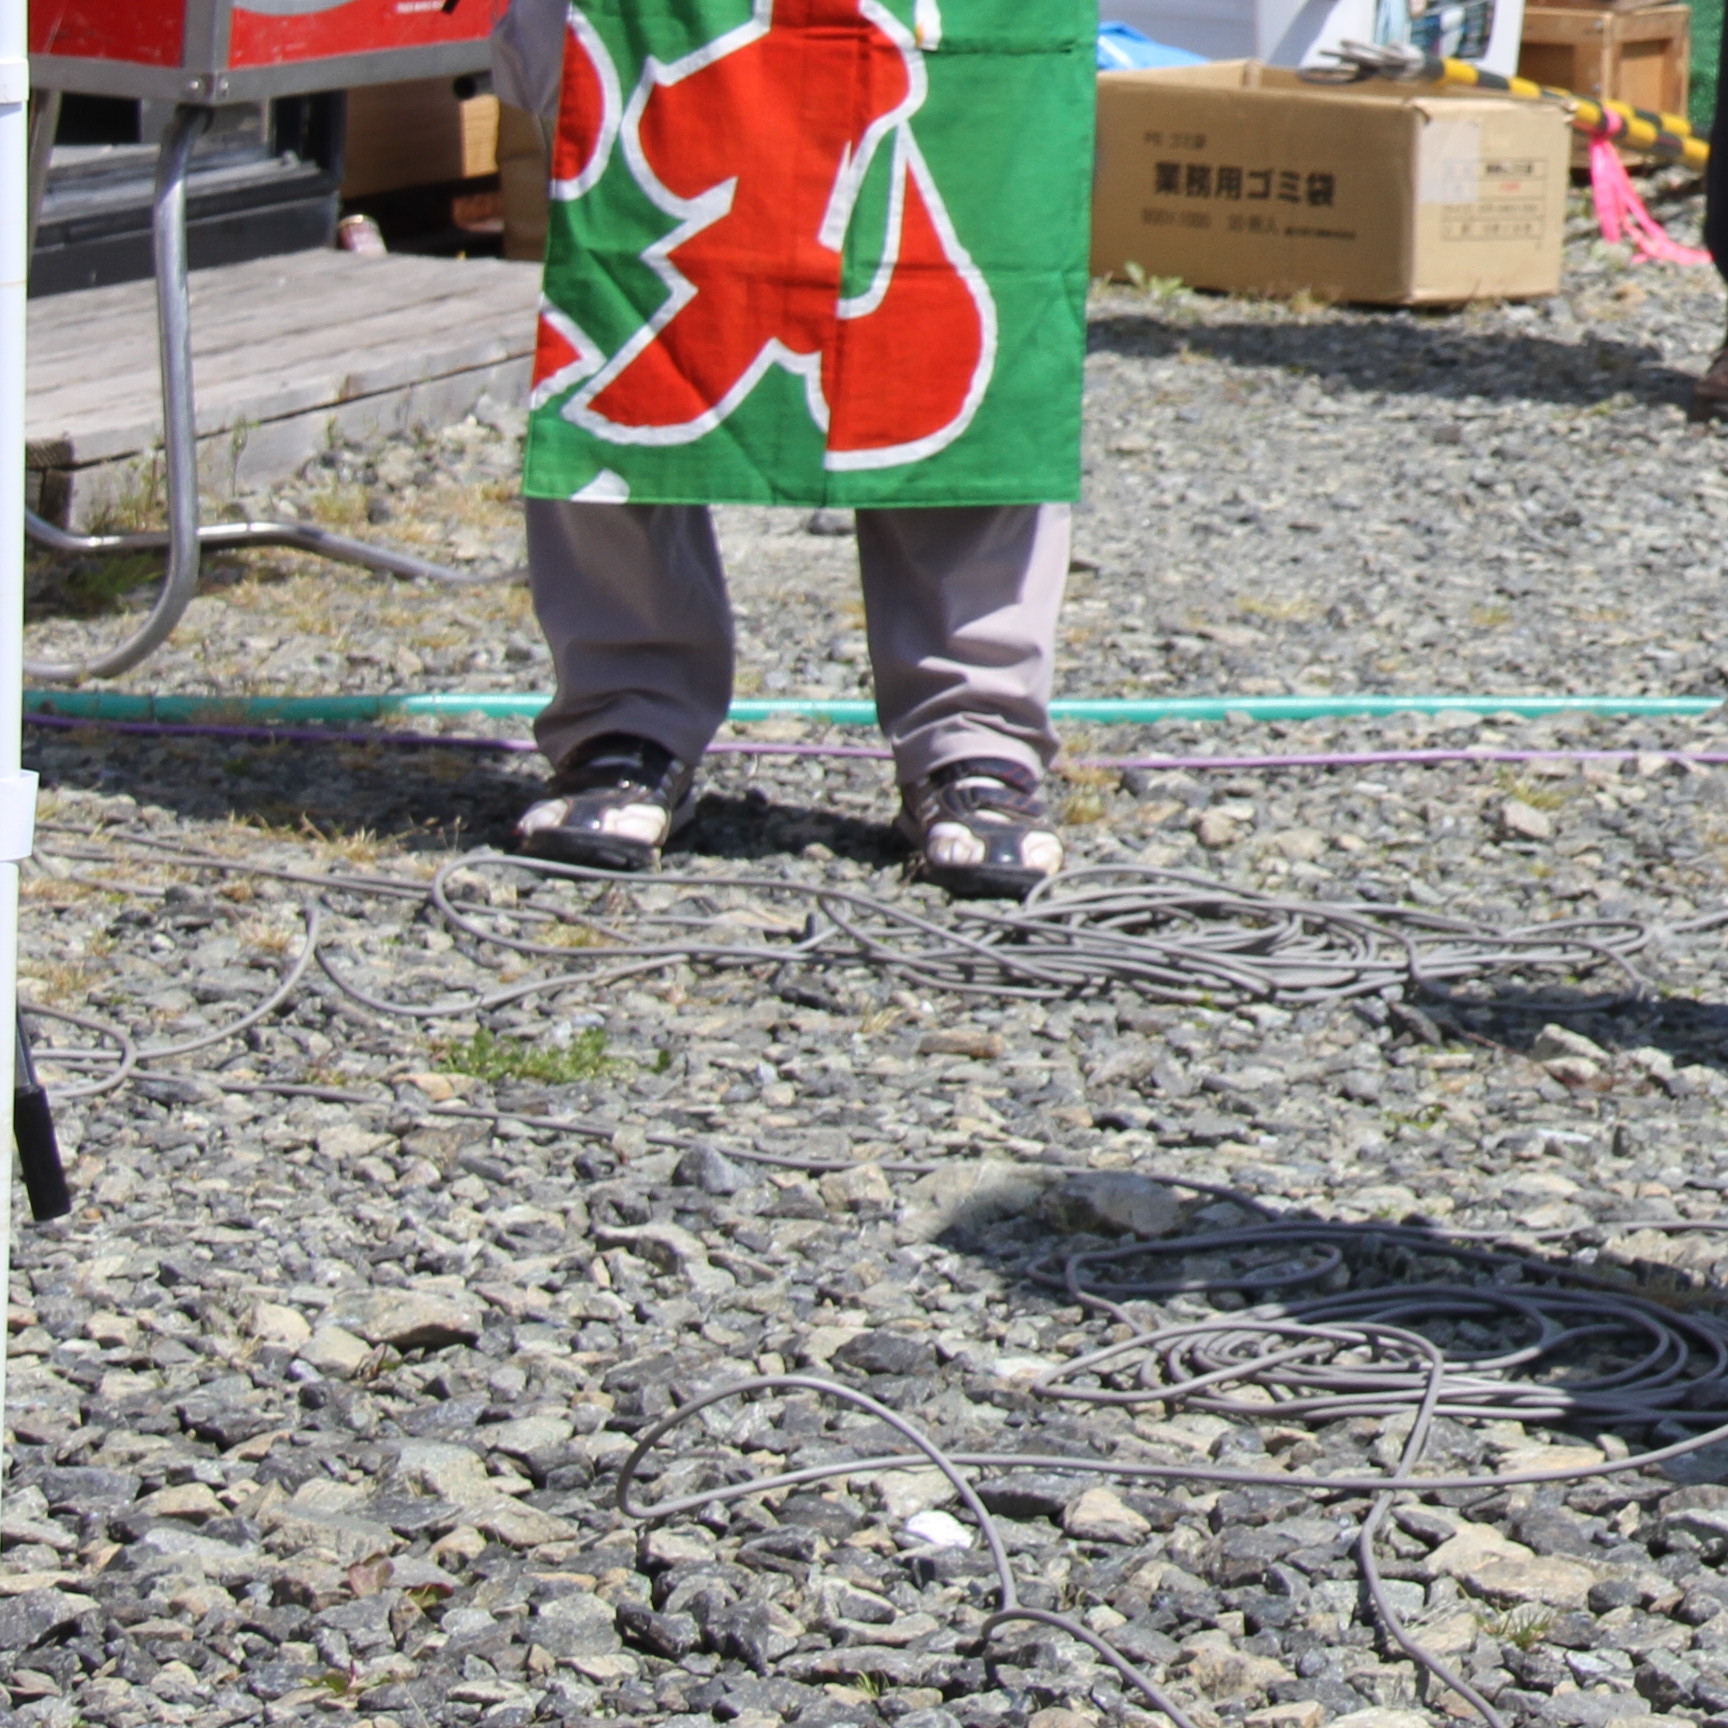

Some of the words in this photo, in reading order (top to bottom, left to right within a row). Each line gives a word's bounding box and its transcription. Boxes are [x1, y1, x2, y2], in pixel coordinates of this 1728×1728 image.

[1153, 160, 1336, 207] 業務用ゴミ袋
